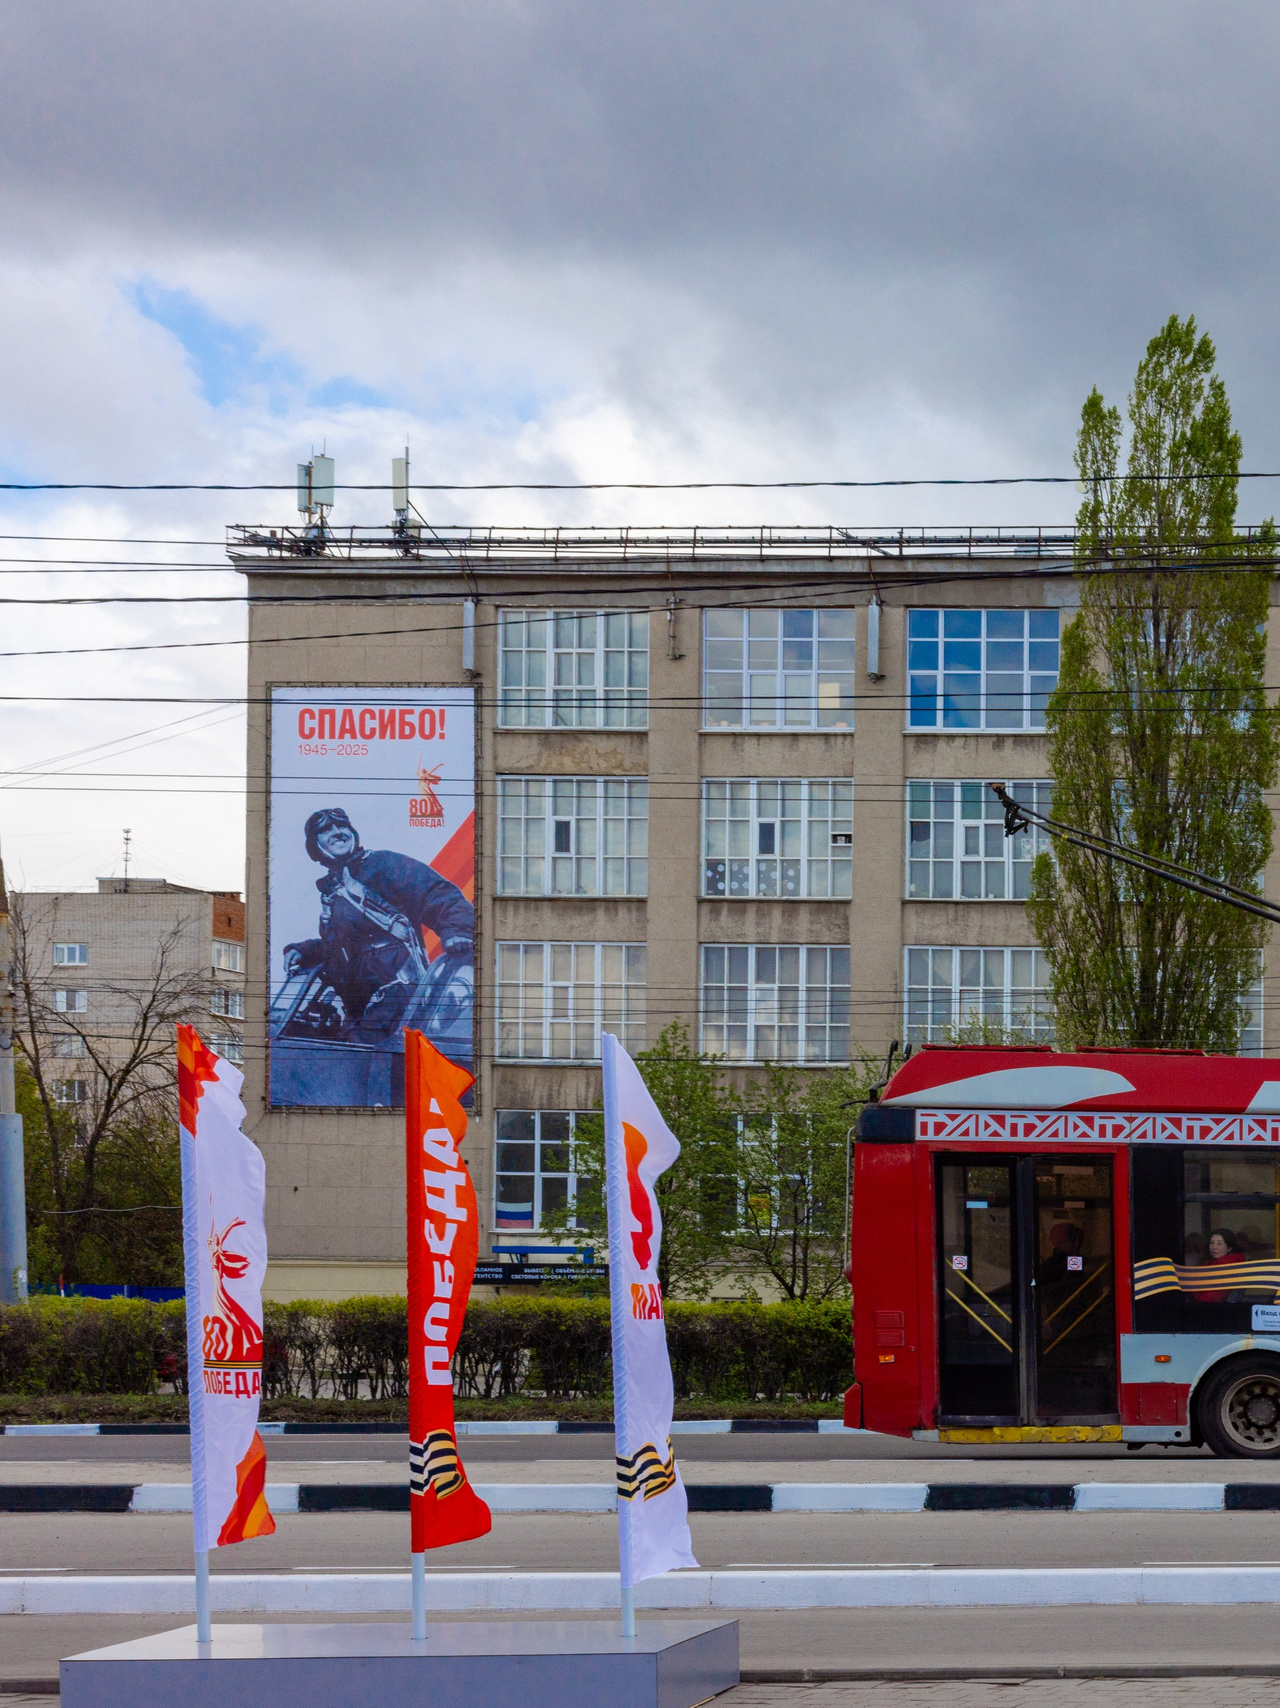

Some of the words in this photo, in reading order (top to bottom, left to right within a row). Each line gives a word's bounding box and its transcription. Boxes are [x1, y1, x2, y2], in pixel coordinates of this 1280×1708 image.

[298, 708, 446, 740] СПАСИБО!
[298, 744, 369, 756] 1945–2025
[409, 798, 429, 816] 80
[409, 818, 445, 828] ПОБЕДА!
